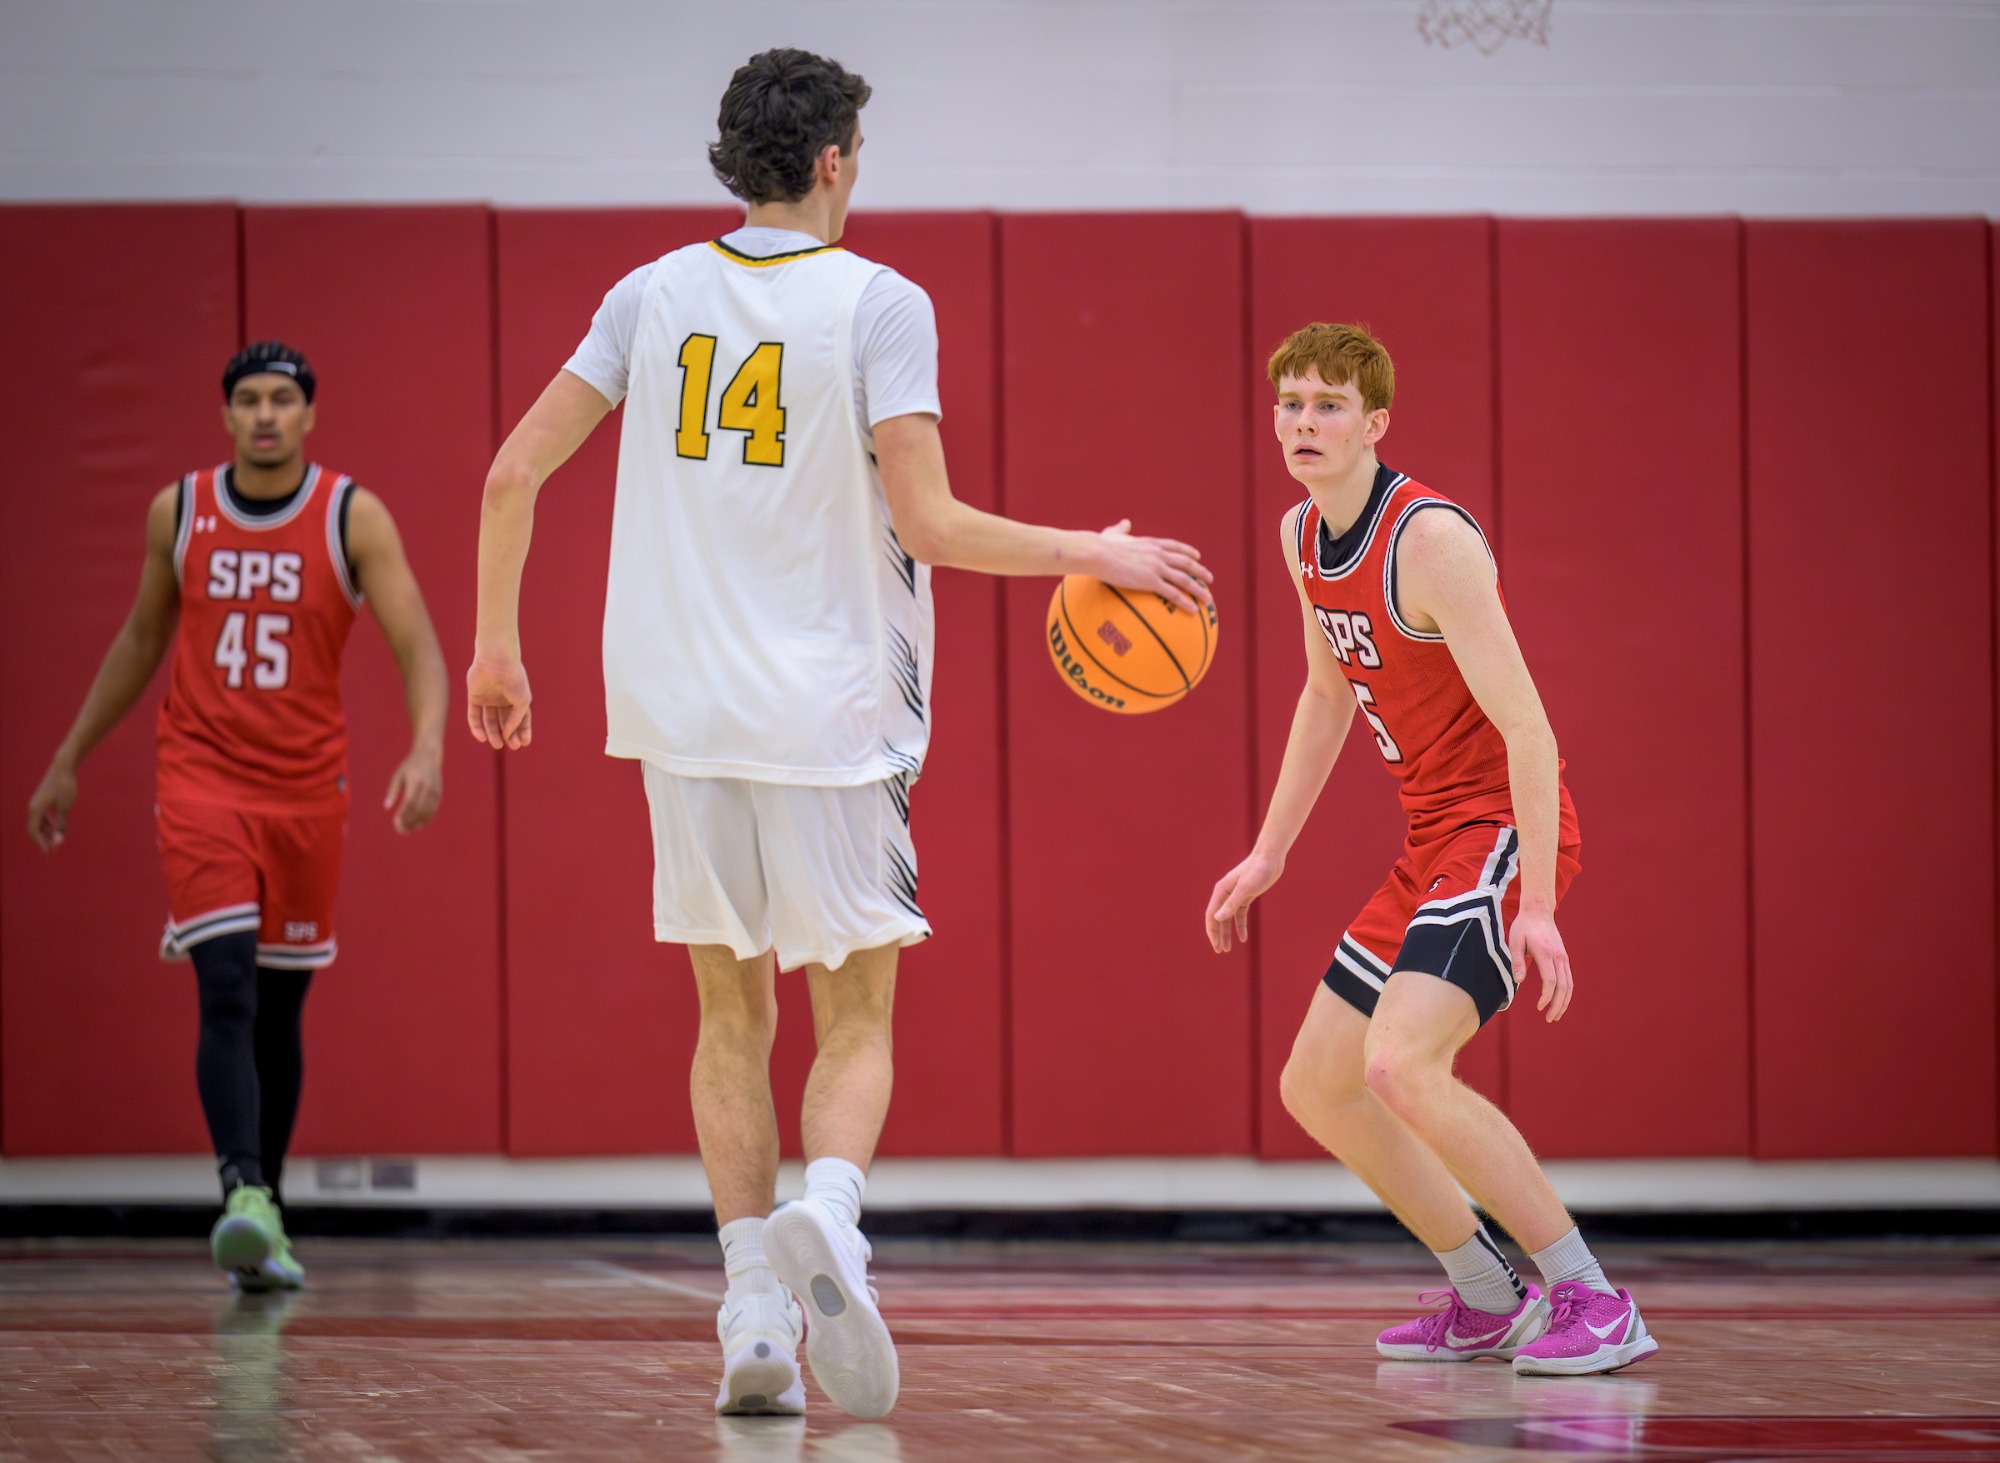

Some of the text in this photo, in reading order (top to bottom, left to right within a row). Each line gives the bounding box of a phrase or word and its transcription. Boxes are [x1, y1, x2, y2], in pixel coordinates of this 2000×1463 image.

[676, 332, 787, 468] 14
[207, 548, 303, 603] SPS
[213, 610, 291, 690] 45
[1050, 617, 1126, 709] Wilson
[1313, 604, 1383, 670] SPS
[1348, 678, 1404, 764] 5
[284, 920, 319, 942] SPS
